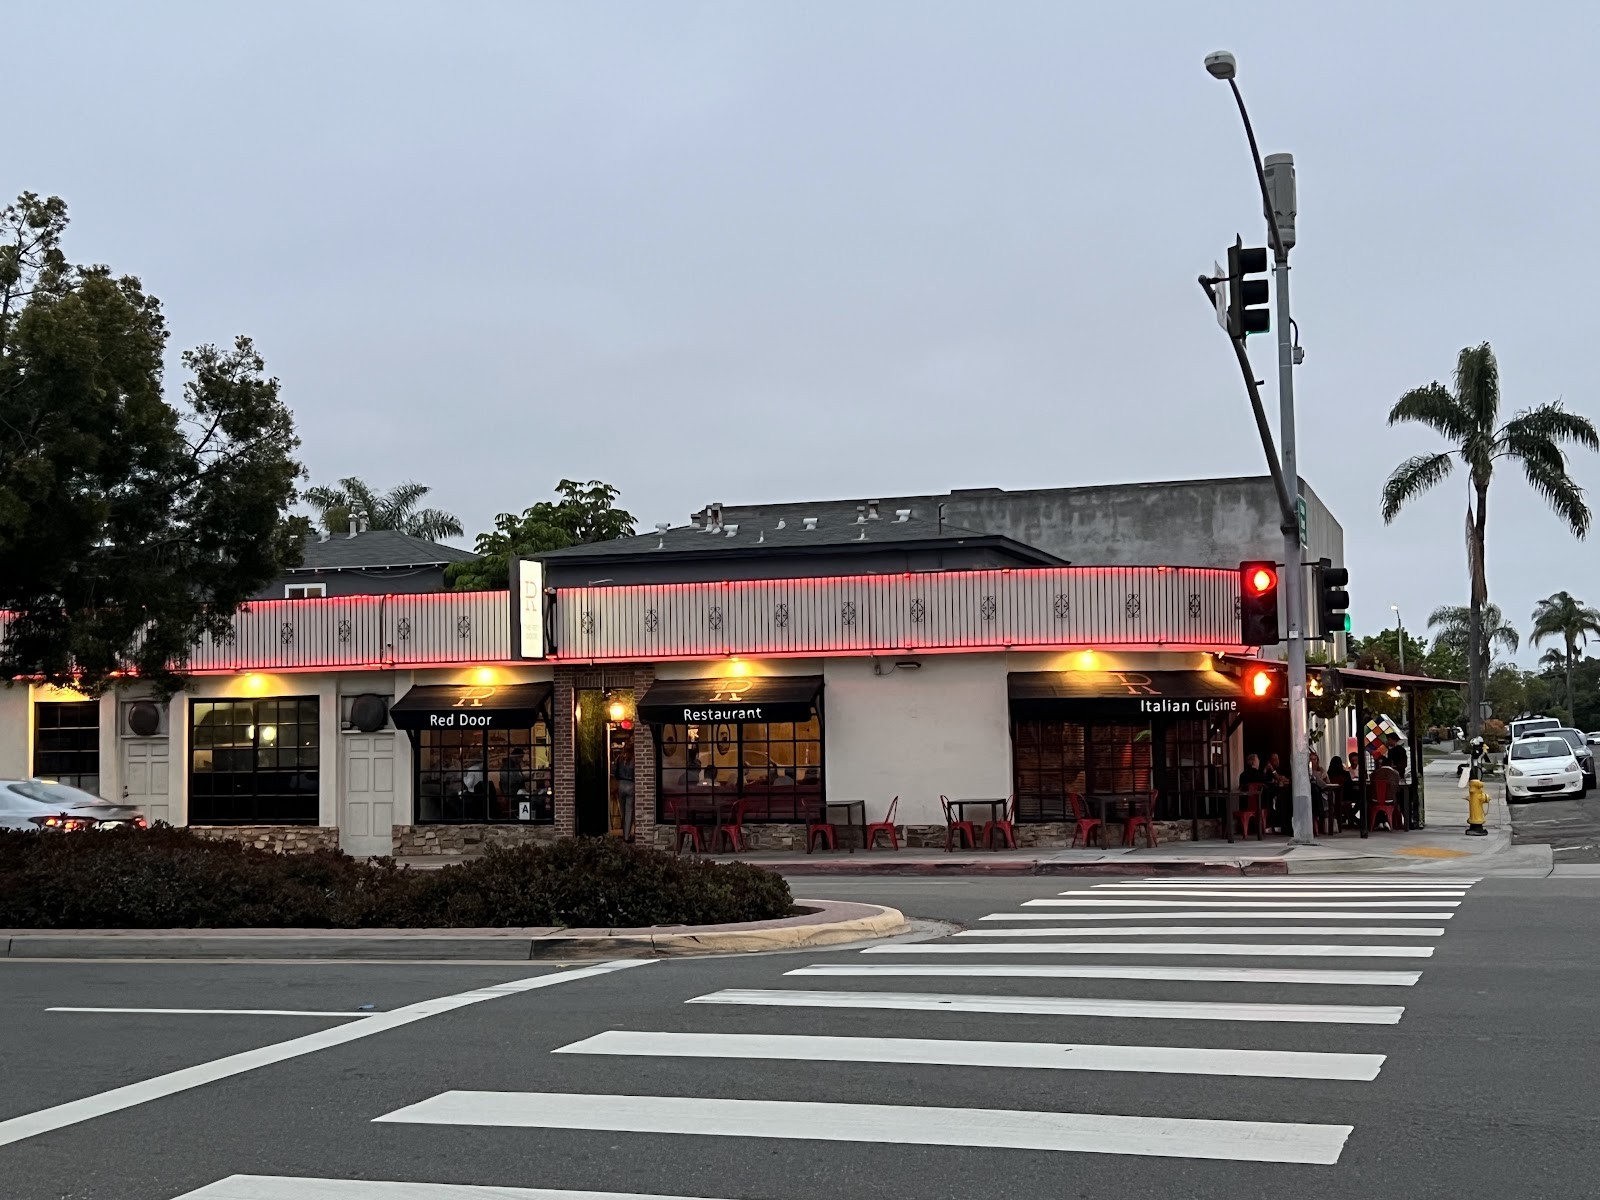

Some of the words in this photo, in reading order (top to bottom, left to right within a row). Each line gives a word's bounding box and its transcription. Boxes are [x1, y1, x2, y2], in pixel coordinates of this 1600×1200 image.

[1141, 699, 1190, 712] Italian
[1195, 699, 1237, 711] Cuisine
[430, 714, 454, 726] Red
[460, 714, 492, 726] Door
[684, 707, 762, 721] Restaurant
[522, 804, 529, 814] A
